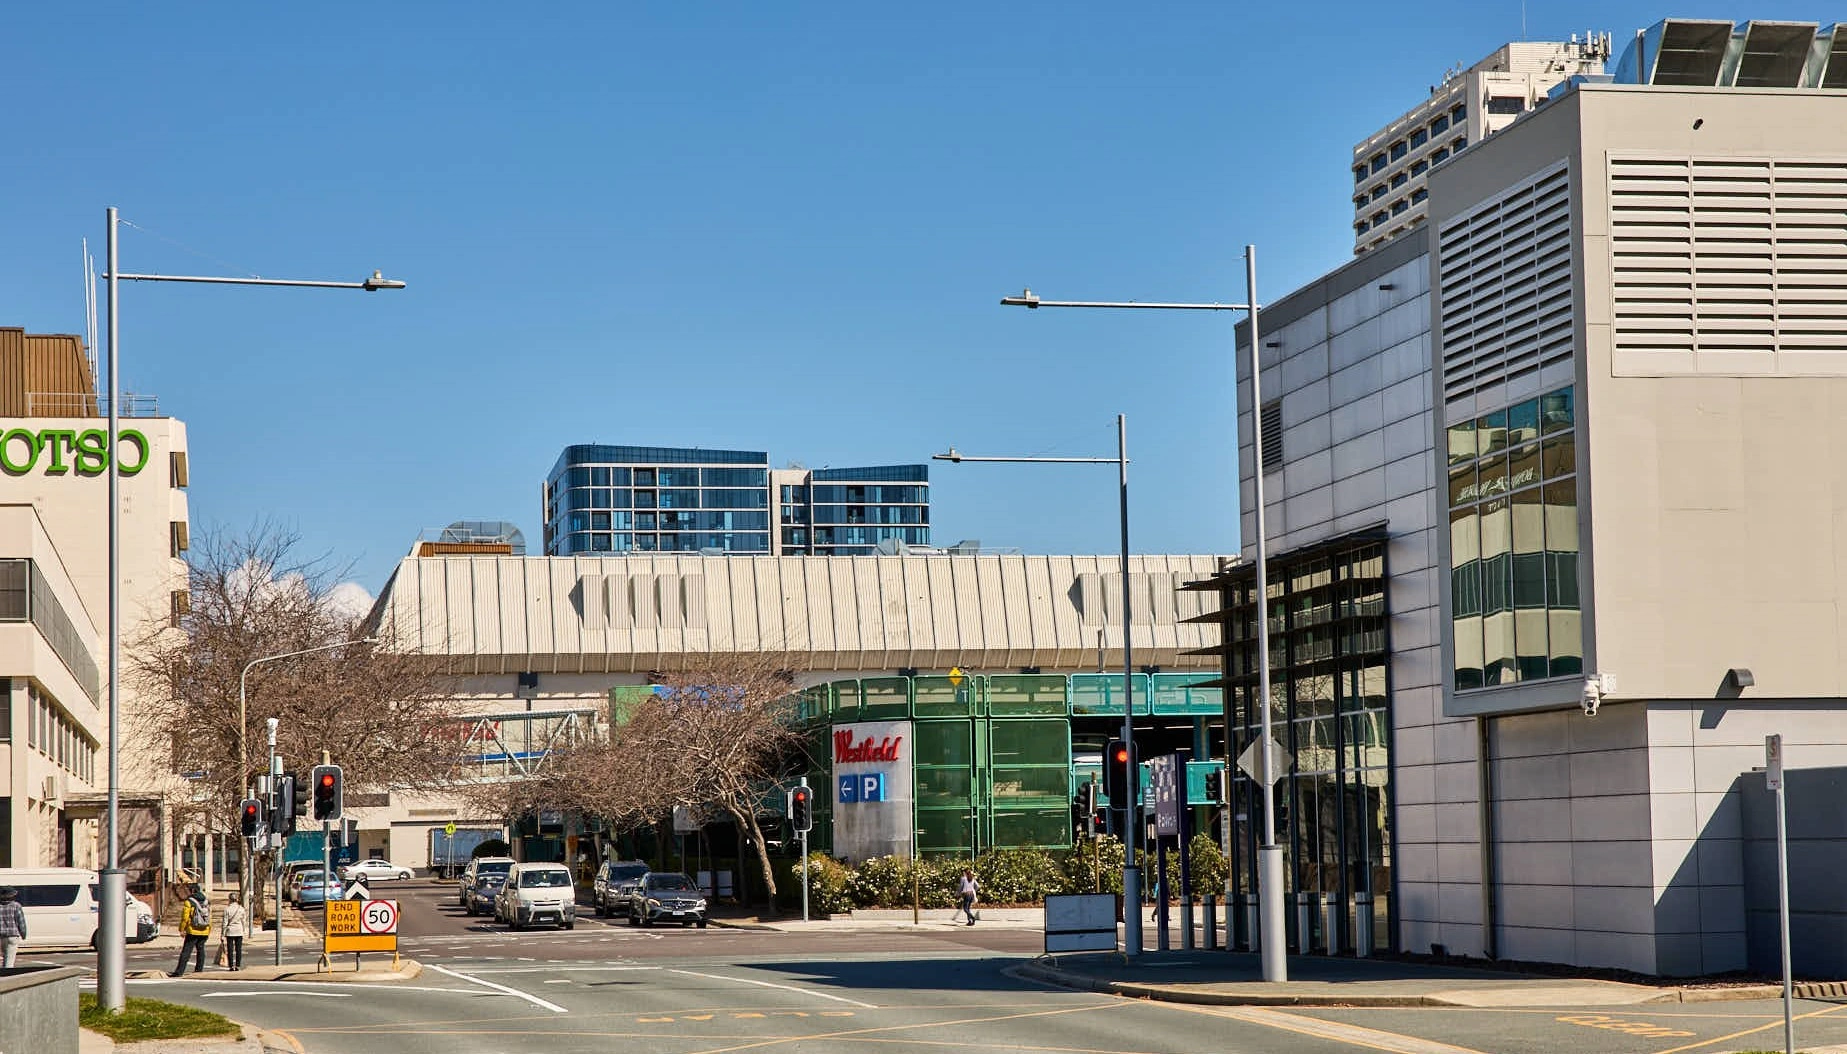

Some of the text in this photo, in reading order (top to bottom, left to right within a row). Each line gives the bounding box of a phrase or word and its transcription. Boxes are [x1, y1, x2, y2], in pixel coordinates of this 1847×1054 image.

[0, 428, 149, 473] OTSO
[833, 729, 903, 763] Westfield
[864, 777, 878, 799] P
[334, 903, 353, 911] END
[331, 913, 356, 921] ROAD
[369, 910, 390, 924] 50
[330, 924, 356, 932] WORK
